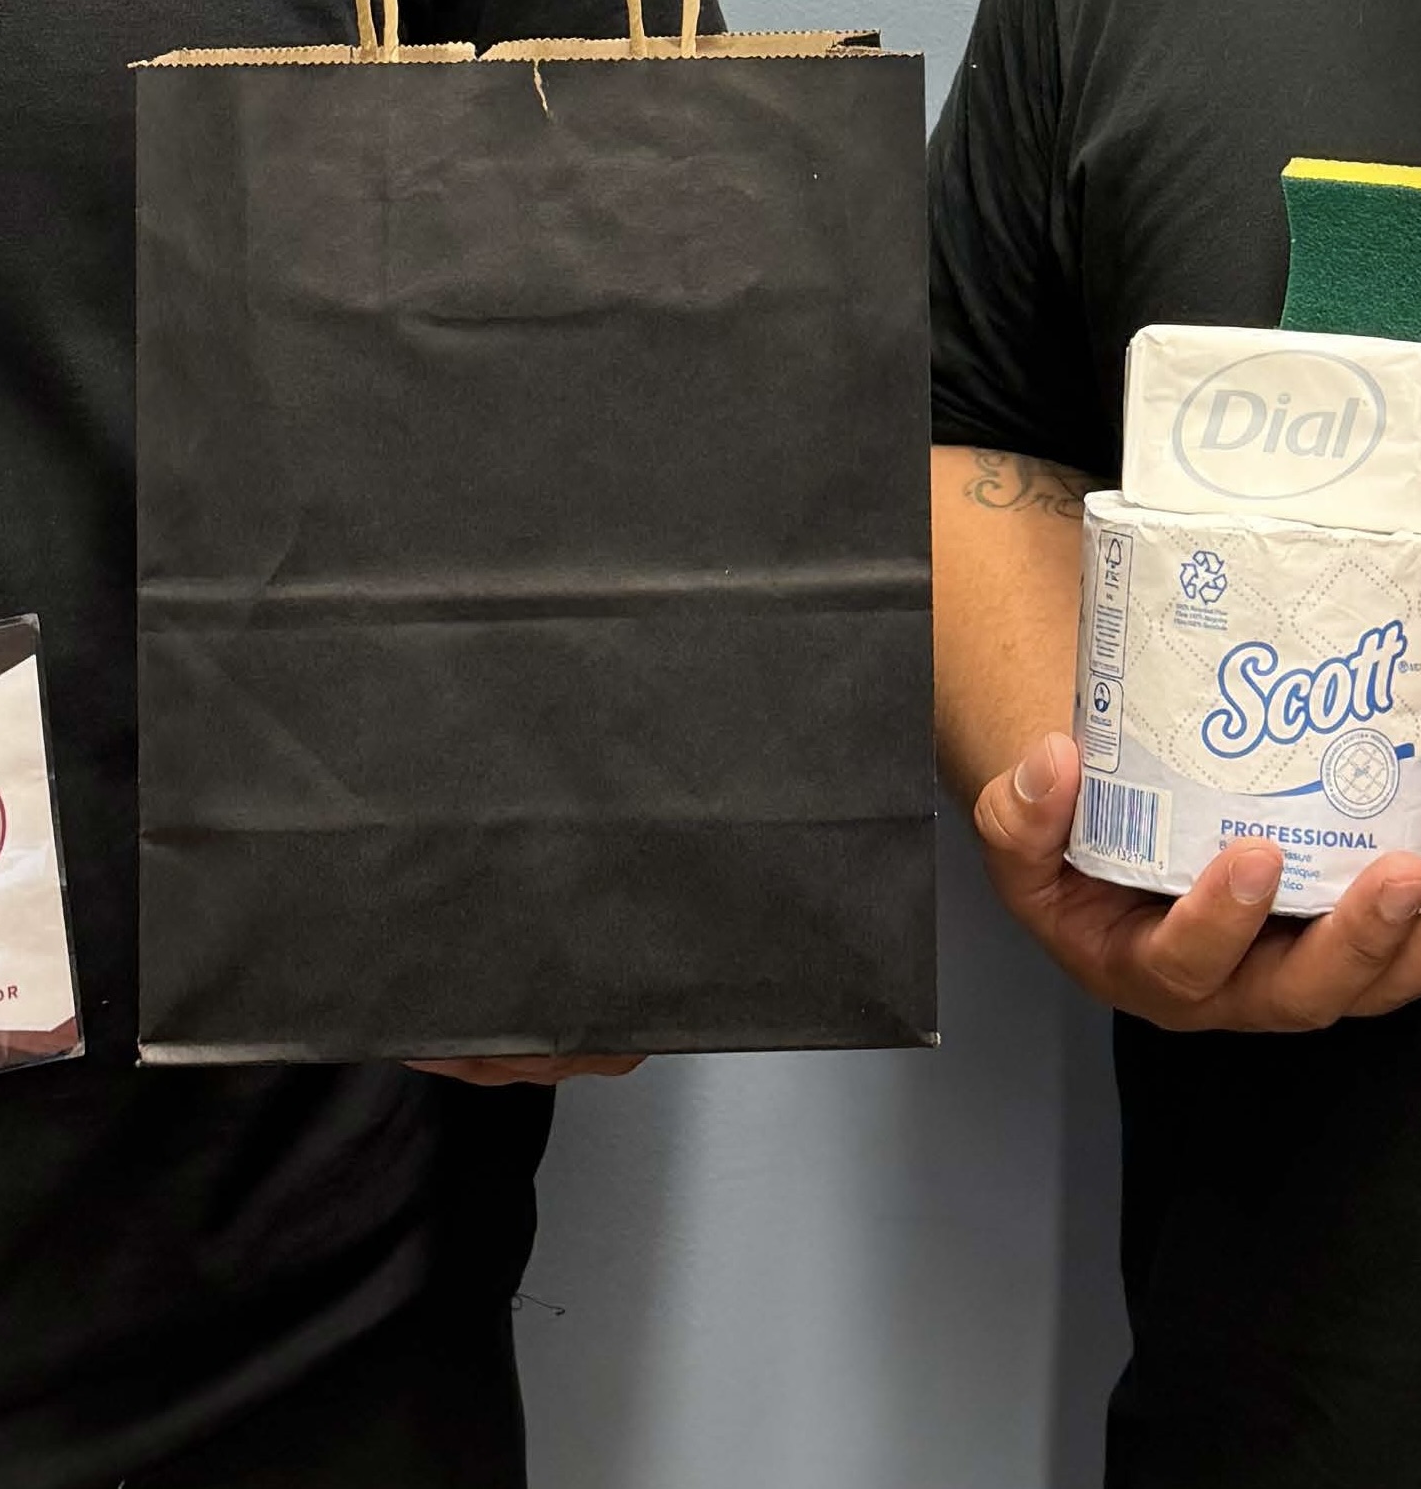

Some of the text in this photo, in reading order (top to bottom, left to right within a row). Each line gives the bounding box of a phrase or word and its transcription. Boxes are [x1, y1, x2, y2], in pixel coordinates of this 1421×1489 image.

[1199, 389, 1362, 459] Dial
[1202, 620, 1408, 759] Scott
[1221, 819, 1378, 849] PROFESSIONAL
